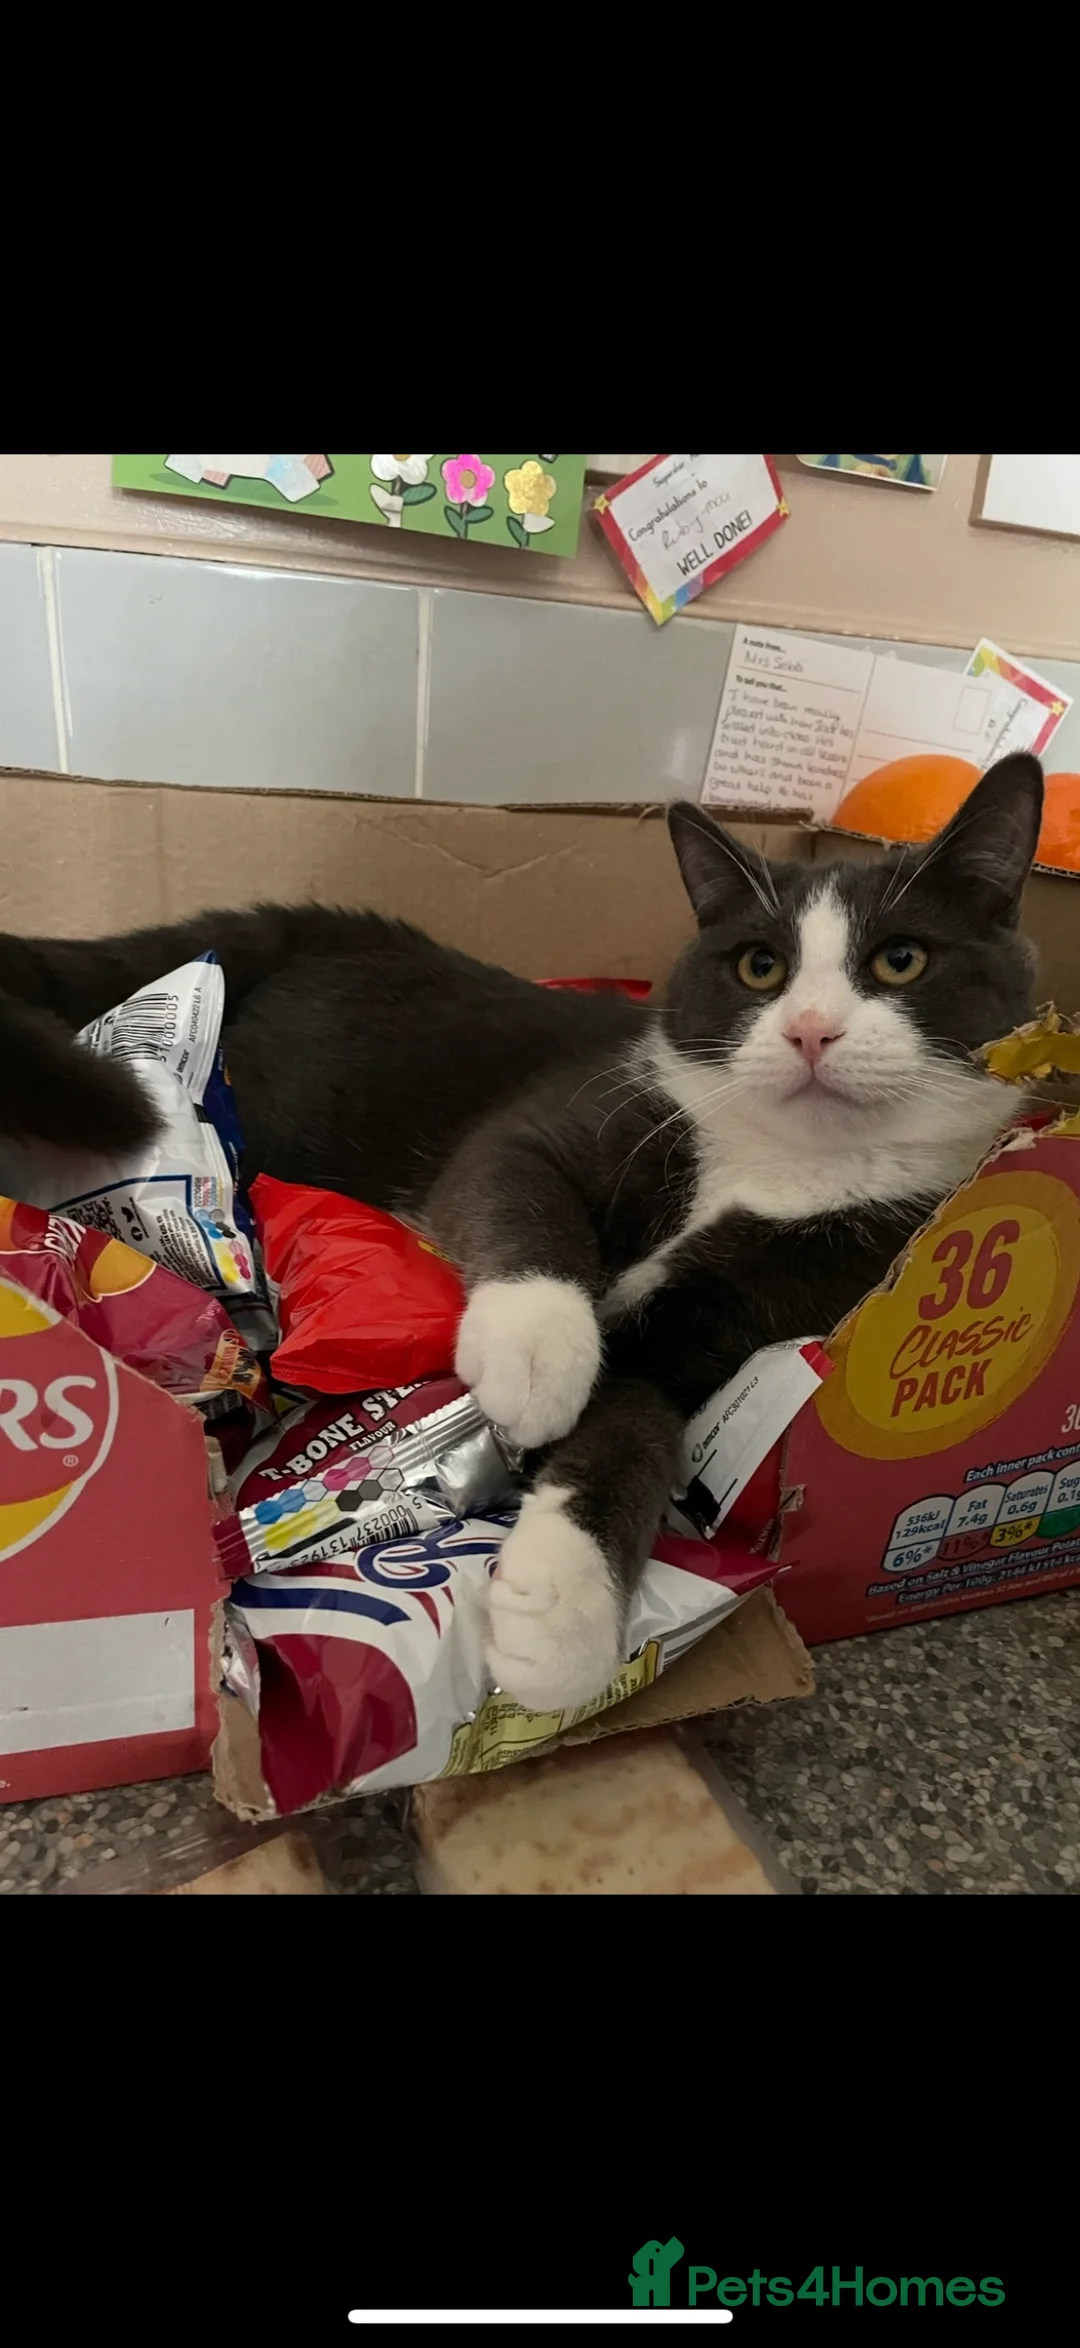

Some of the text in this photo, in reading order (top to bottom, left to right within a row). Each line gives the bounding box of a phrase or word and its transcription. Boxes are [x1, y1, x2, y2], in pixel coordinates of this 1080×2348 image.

[628, 479, 708, 542] Congratulations to
[676, 509, 753, 576] WELL DONE!
[742, 637, 748, 645] A
[749, 638, 764, 649] note
[735, 674, 742, 683] To
[744, 676, 755, 686] tell
[755, 680, 768, 690] you
[743, 691, 770, 707] have
[752, 737, 784, 752] hard
[714, 747, 739, 760] and
[744, 750, 766, 765] has
[769, 770, 793, 783] and
[747, 780, 773, 795] help
[176, 1049, 191, 1074] amcor
[918, 1219, 1020, 1321] 36
[890, 1358, 994, 1418] PACK
[349, 1420, 397, 1451] FLAVOUR
[702, 1421, 720, 1450] amcor
[257, 1413, 365, 1481] T-BONE
[966, 1464, 995, 1483] Each
[996, 1457, 1026, 1475] inner
[1027, 1449, 1055, 1469] pack
[411, 1496, 423, 1510] 5
[1004, 1483, 1049, 1504] Saturates
[967, 1499, 988, 1513] Fat
[1007, 1501, 1038, 1516] 0.6g
[356, 1503, 407, 1536] 000237
[895, 1519, 945, 1540] 129kcal
[957, 1512, 989, 1529] 7.4g
[868, 1579, 906, 1597] Based
[907, 1575, 924, 1587] on
[926, 1570, 949, 1583] Salt
[950, 1567, 960, 1577] &
[962, 1557, 1006, 1576] Vinegar
[1007, 1543, 1049, 1562] Flavour
[898, 1584, 941, 1604] Energy
